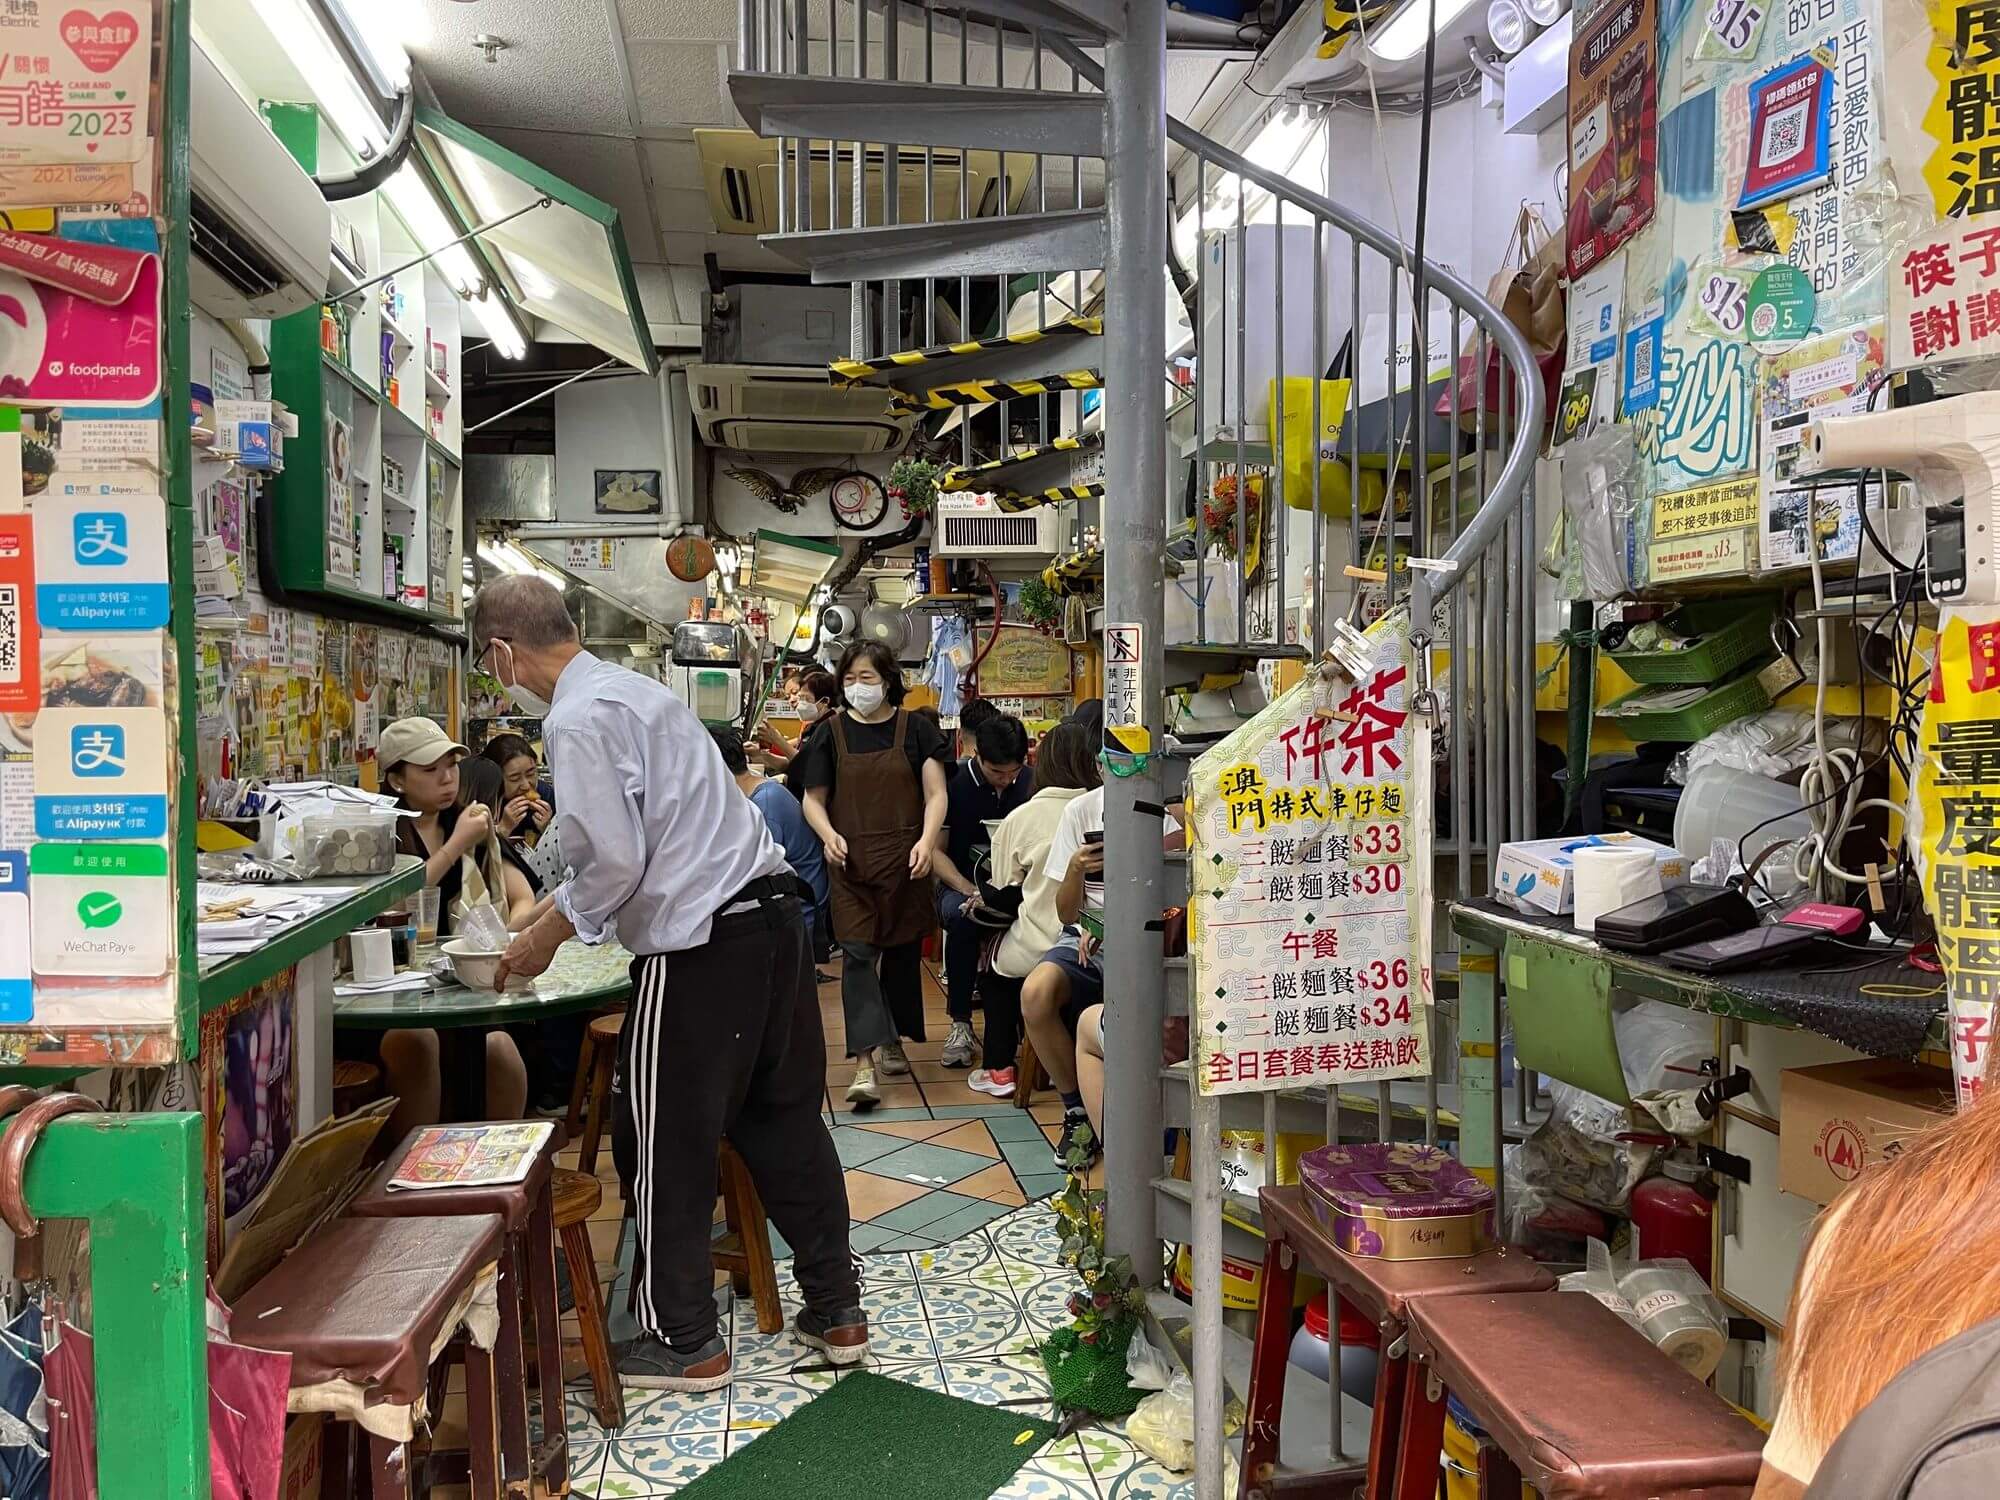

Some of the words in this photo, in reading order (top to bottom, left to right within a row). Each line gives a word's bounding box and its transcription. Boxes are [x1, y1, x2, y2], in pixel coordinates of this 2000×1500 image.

[1588, 5, 1634, 61] 可口可樂
[1710, 0, 1760, 49] $15
[67, 112, 134, 137] 2023
[32, 167, 74, 184] 2021
[1782, 308, 1793, 329] 5
[69, 362, 142, 378] foodpanda
[1122, 667, 1137, 724] 非工作人員
[1353, 824, 1402, 856] $33
[73, 855, 127, 868] 歡迎使用
[1241, 872, 1350, 903] 二餸麵餐
[1352, 864, 1402, 895] $30
[63, 940, 106, 952] WeChat
[108, 941, 128, 955] Pay
[1282, 928, 1339, 961] 午餐
[1243, 967, 1355, 1002] 三餸麵餐
[1357, 958, 1409, 990] $36
[1244, 1004, 1358, 1037] 二餸麵餐
[1360, 995, 1412, 1027] $34
[1207, 1036, 1420, 1083] 全日套餐奉送熱飲
